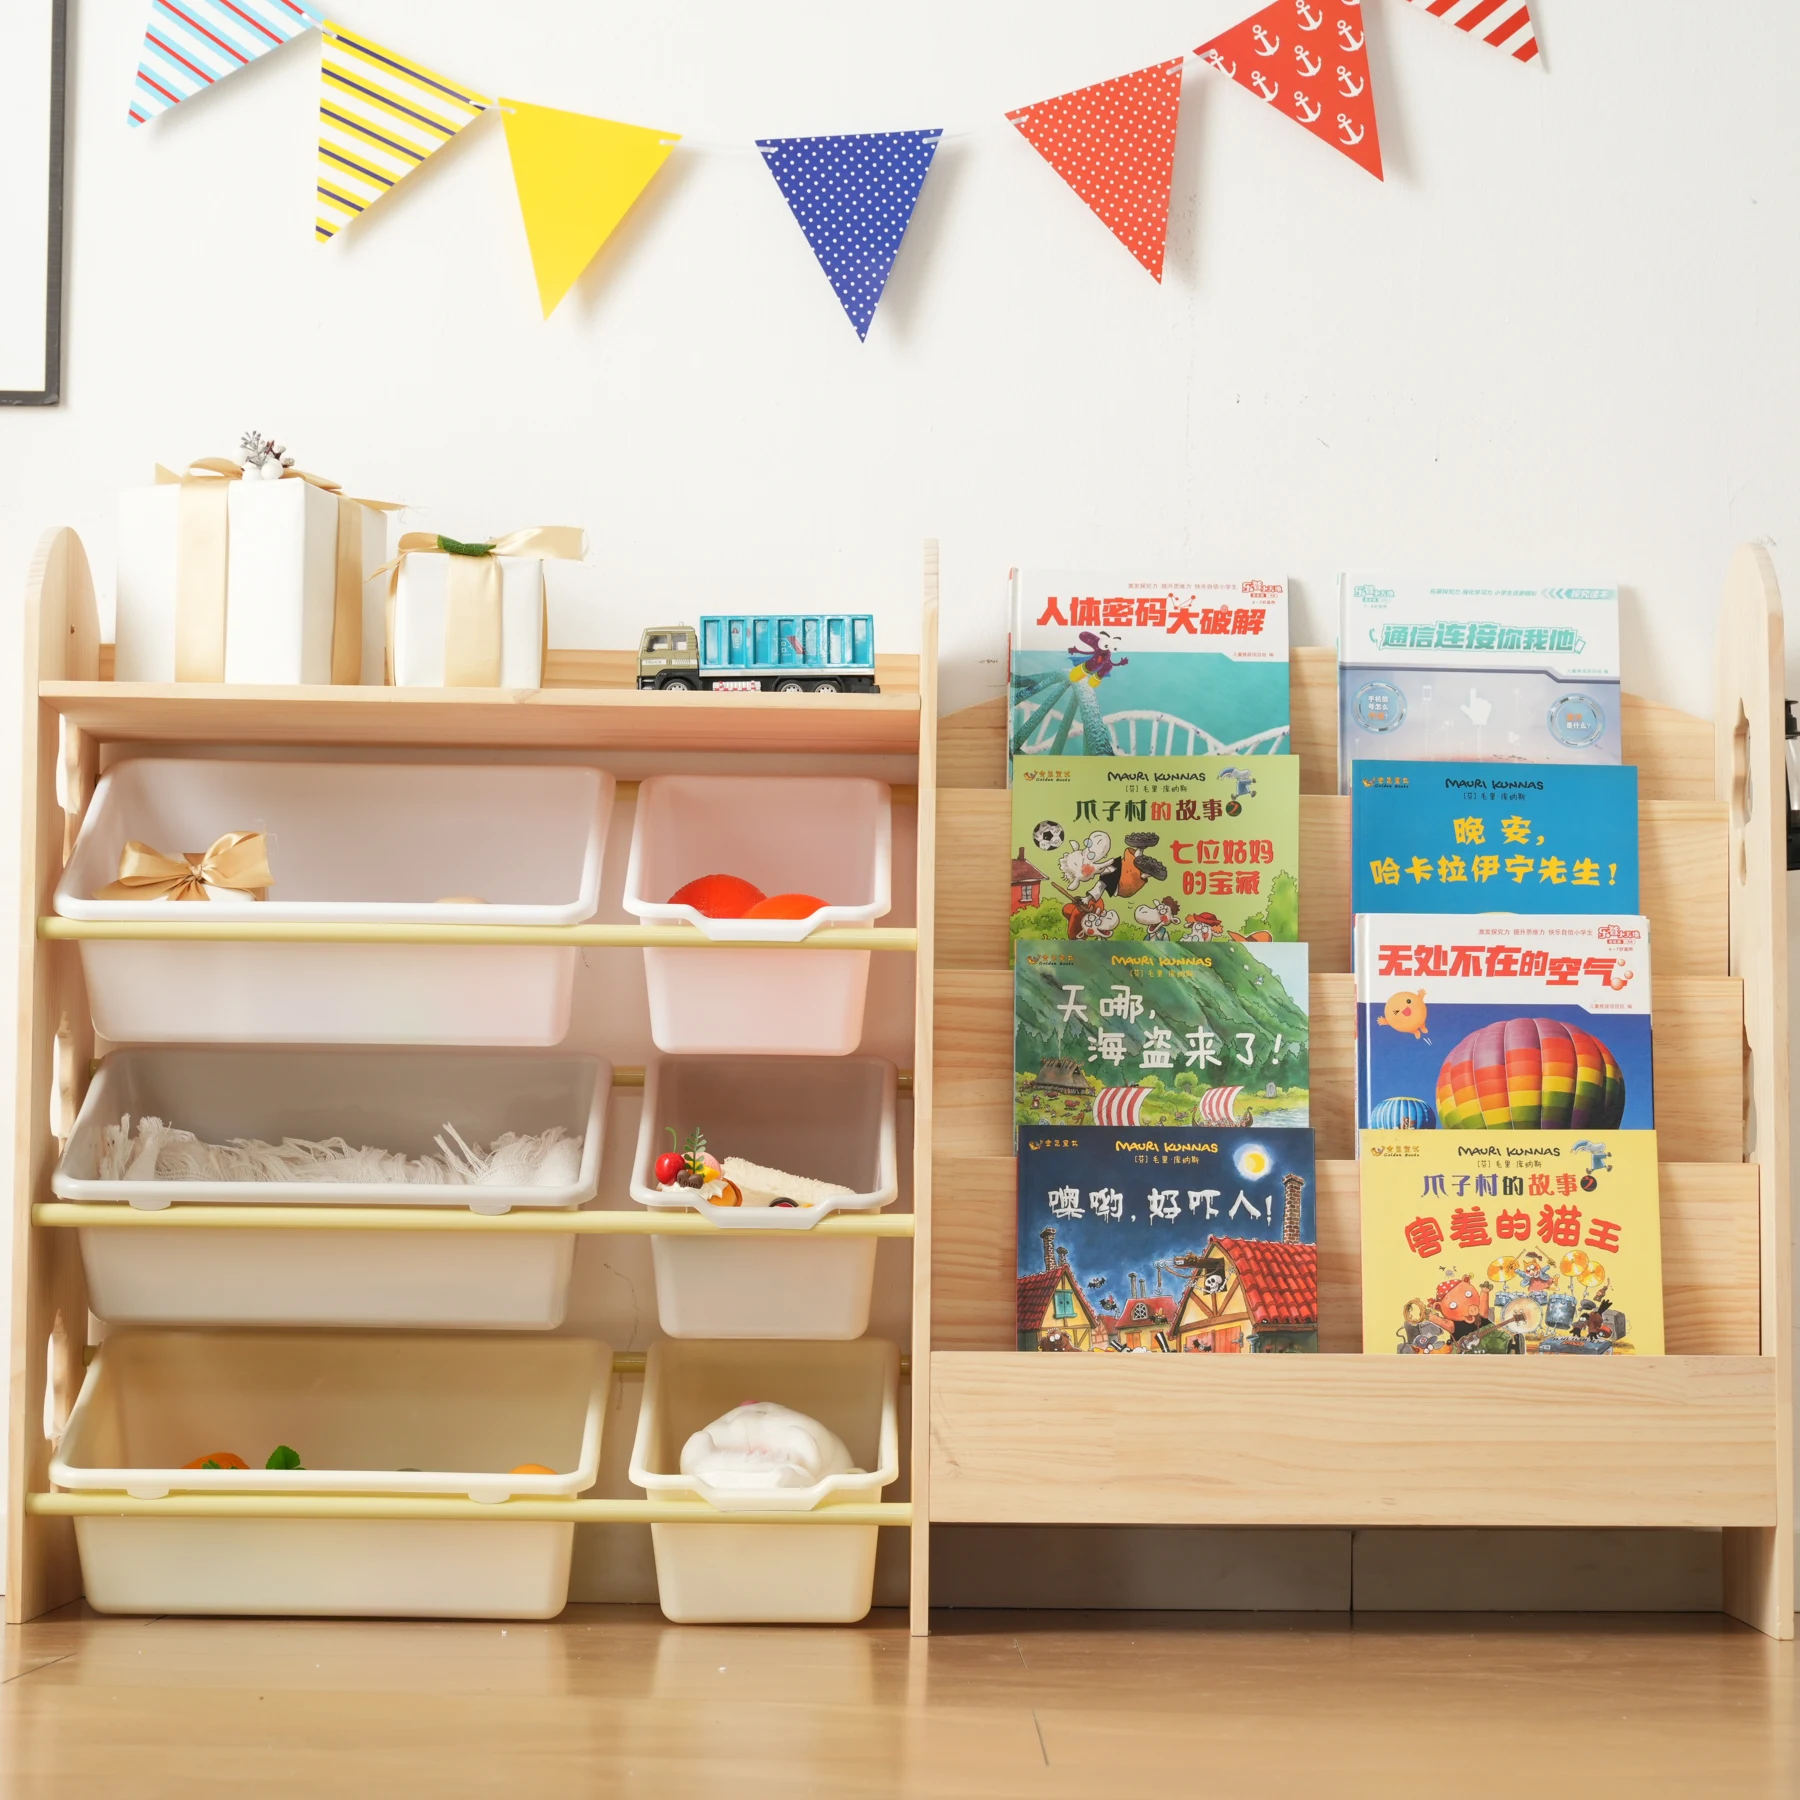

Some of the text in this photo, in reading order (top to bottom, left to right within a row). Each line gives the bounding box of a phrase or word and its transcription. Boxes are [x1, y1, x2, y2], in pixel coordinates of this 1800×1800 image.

[1036, 596, 1267, 636] 人体密码大破解
[1380, 621, 1578, 653] 通信连接你我他
[1154, 771, 1206, 783] KUNNAS
[1492, 779, 1544, 790] KUNNAS
[1169, 838, 1274, 865] 七位姑妈
[1182, 870, 1261, 896] 的宝藏
[1159, 955, 1212, 968] KUNNAS
[1377, 944, 1629, 987] 无处不在的空气
[1164, 1141, 1219, 1153] KUNNAS
[1506, 1146, 1561, 1157] KUNNAS
[1404, 1204, 1622, 1259] 害羞的猫王
